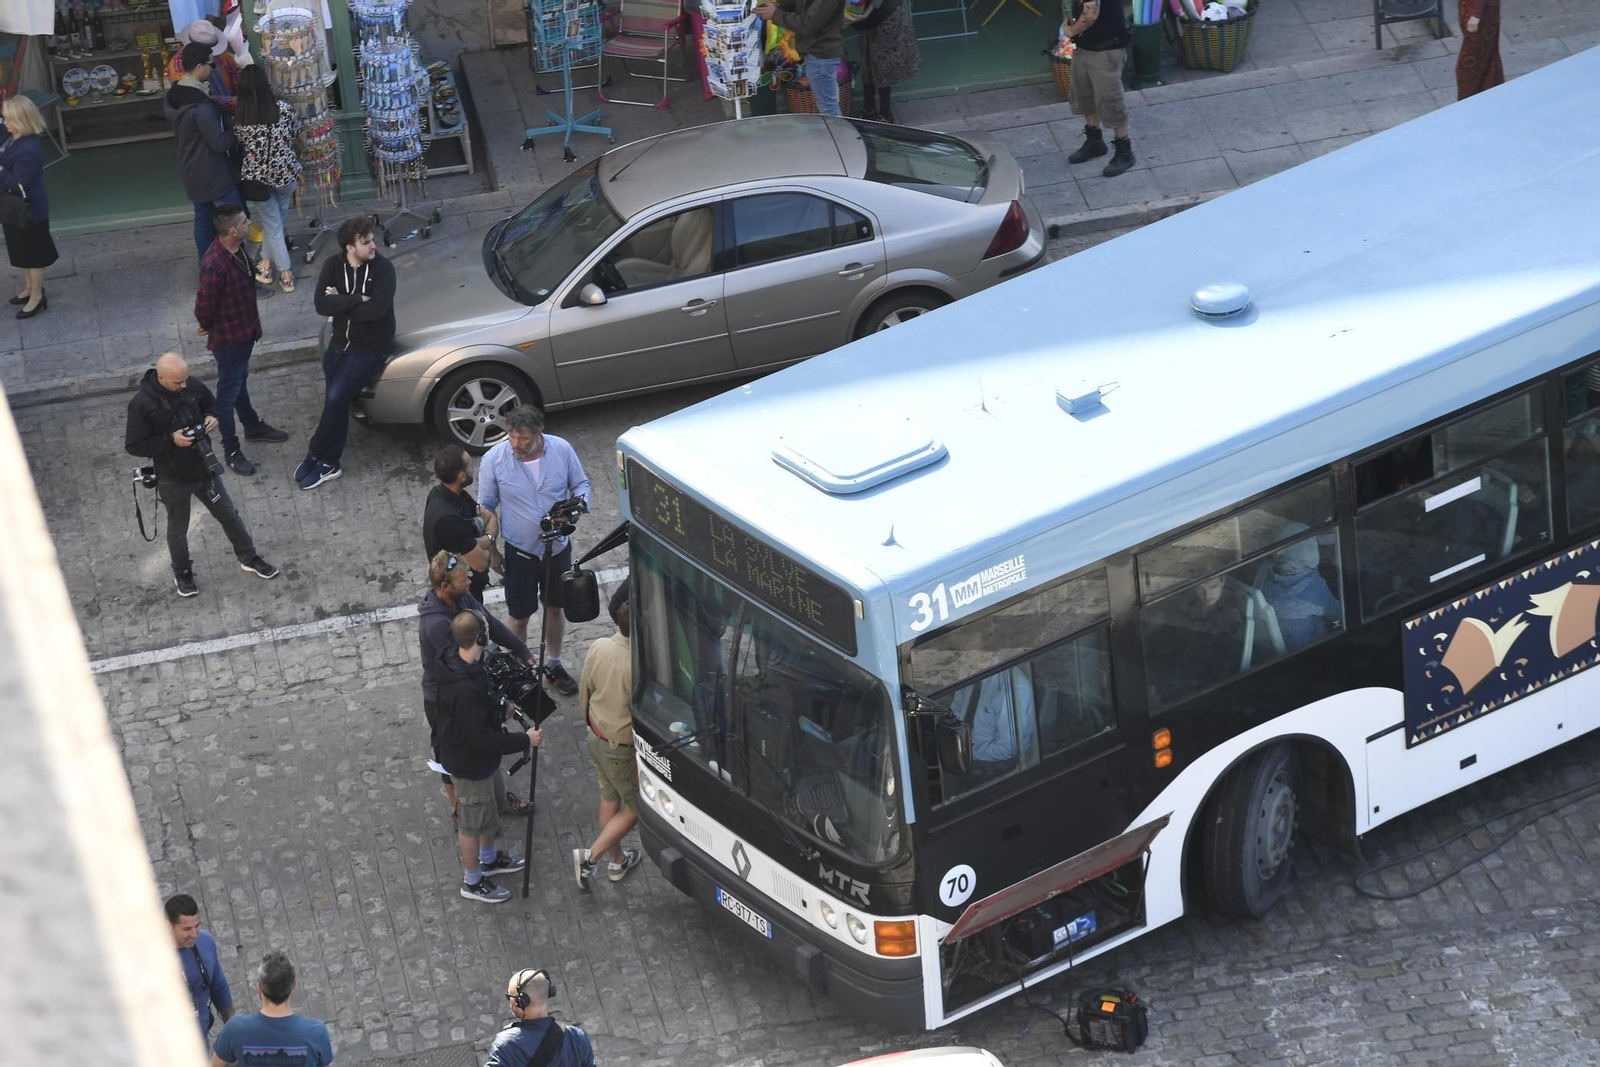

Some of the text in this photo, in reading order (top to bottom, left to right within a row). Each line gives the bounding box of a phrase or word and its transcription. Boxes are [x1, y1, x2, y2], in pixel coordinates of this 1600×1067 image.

[654, 483, 685, 536] 31
[709, 514, 735, 549] LA
[712, 539, 825, 626] LA MARINE
[980, 554, 1025, 584] MARSEILLE
[983, 571, 1027, 597] METROPOLE
[908, 582, 949, 632] 31
[955, 580, 979, 604] MM
[819, 862, 871, 906] MTR
[946, 873, 969, 900] 70
